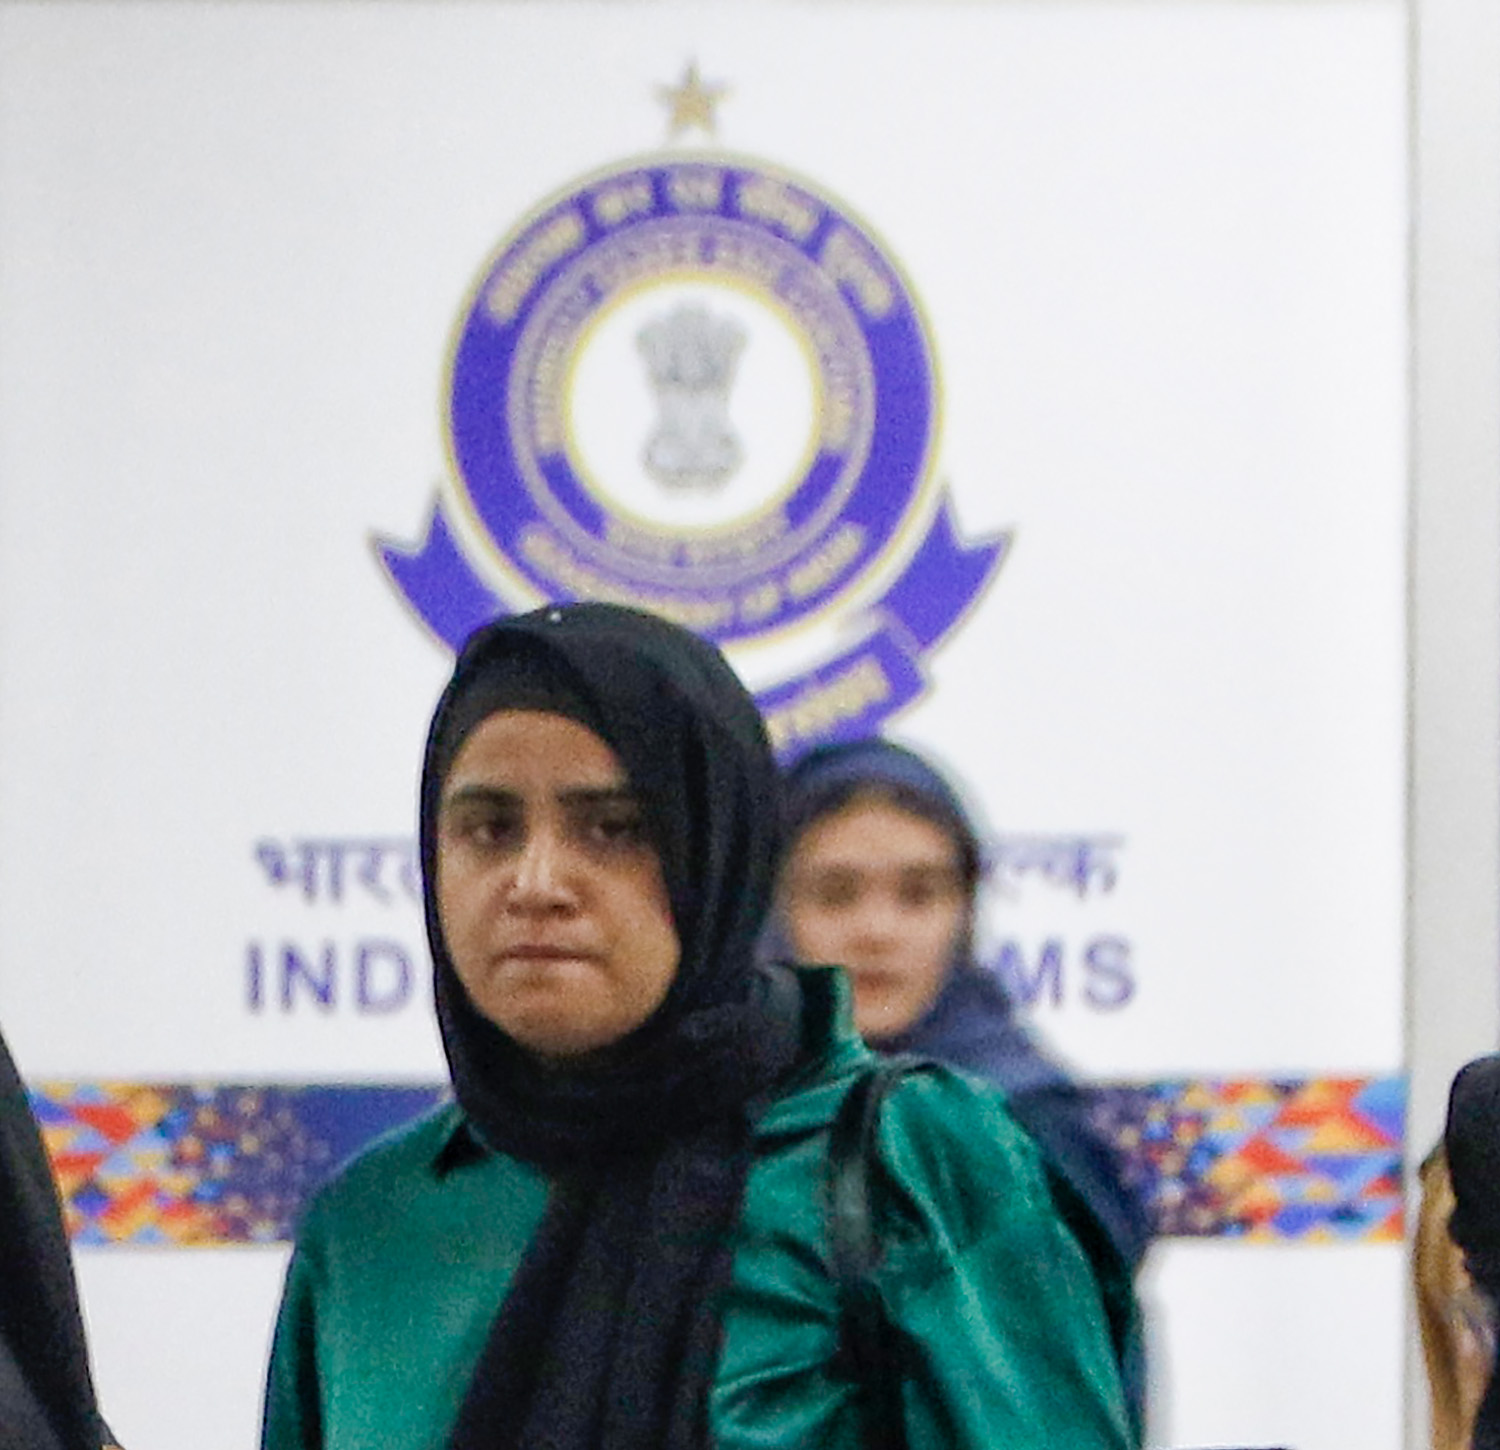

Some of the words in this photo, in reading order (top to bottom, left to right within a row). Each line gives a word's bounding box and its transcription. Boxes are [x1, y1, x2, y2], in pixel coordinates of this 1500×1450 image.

[978, 832, 1128, 903] ल्क
[245, 937, 417, 1013] IND
[995, 933, 1138, 1012] MS
